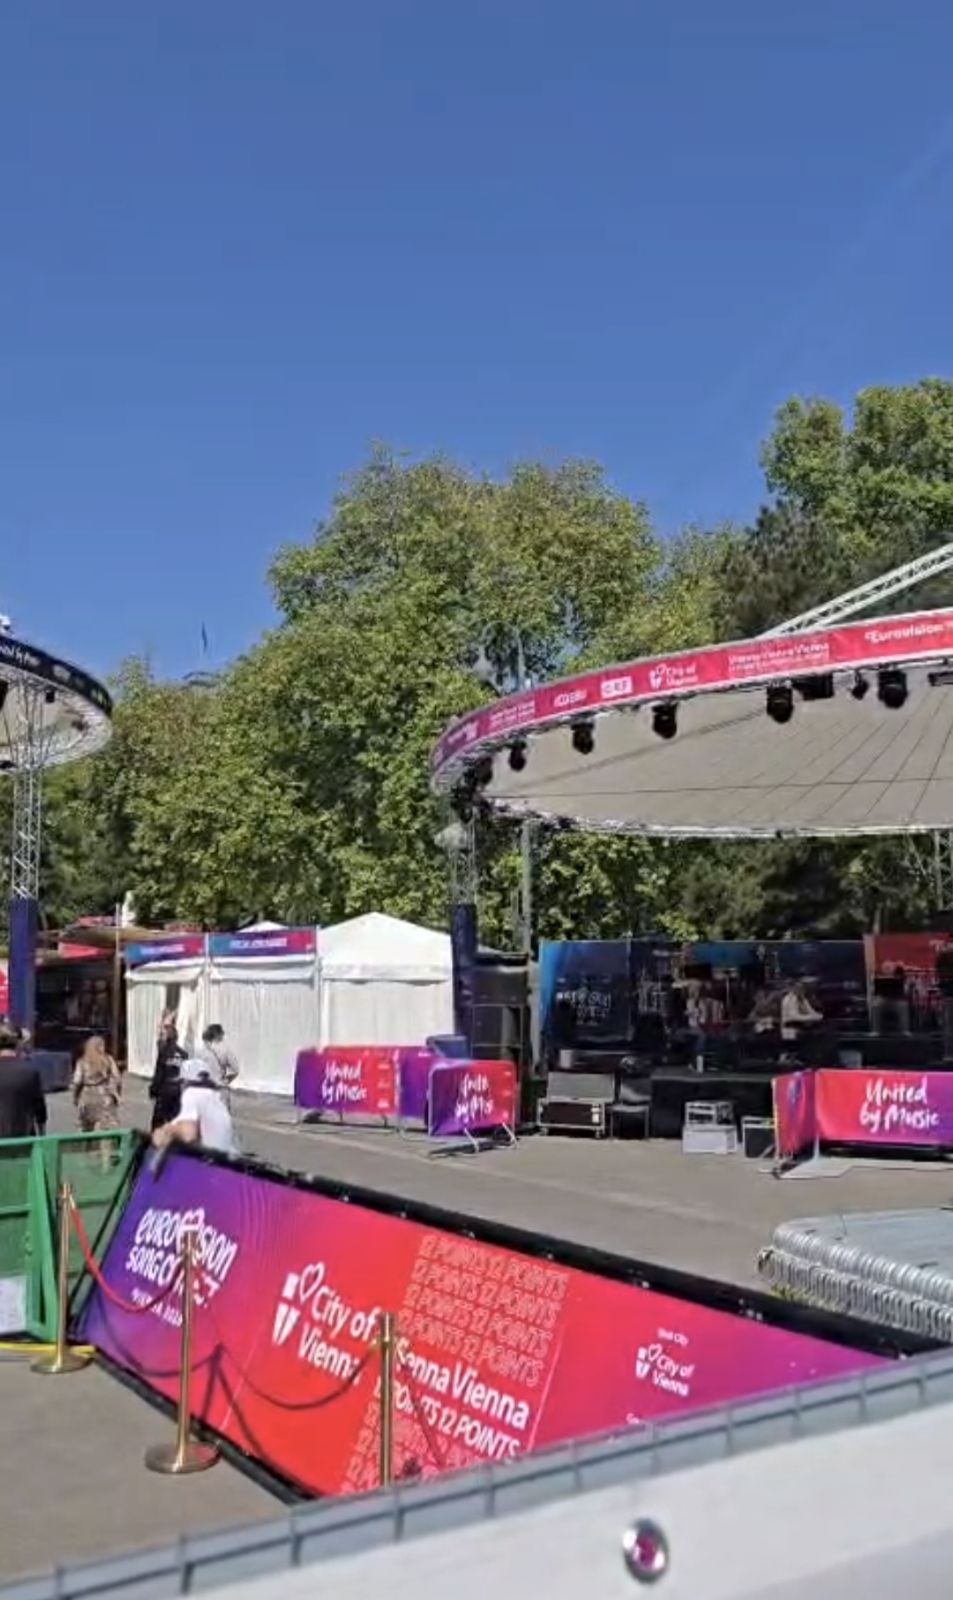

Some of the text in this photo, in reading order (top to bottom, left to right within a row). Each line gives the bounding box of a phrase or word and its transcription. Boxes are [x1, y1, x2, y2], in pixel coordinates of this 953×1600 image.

[866, 1074, 928, 1107] United
[860, 1101, 941, 1134] by Music
[311, 1284, 383, 1342] City of
[656, 1354, 695, 1378] City of
[652, 1369, 690, 1397] Vienna
[438, 1406, 458, 1435] 12
